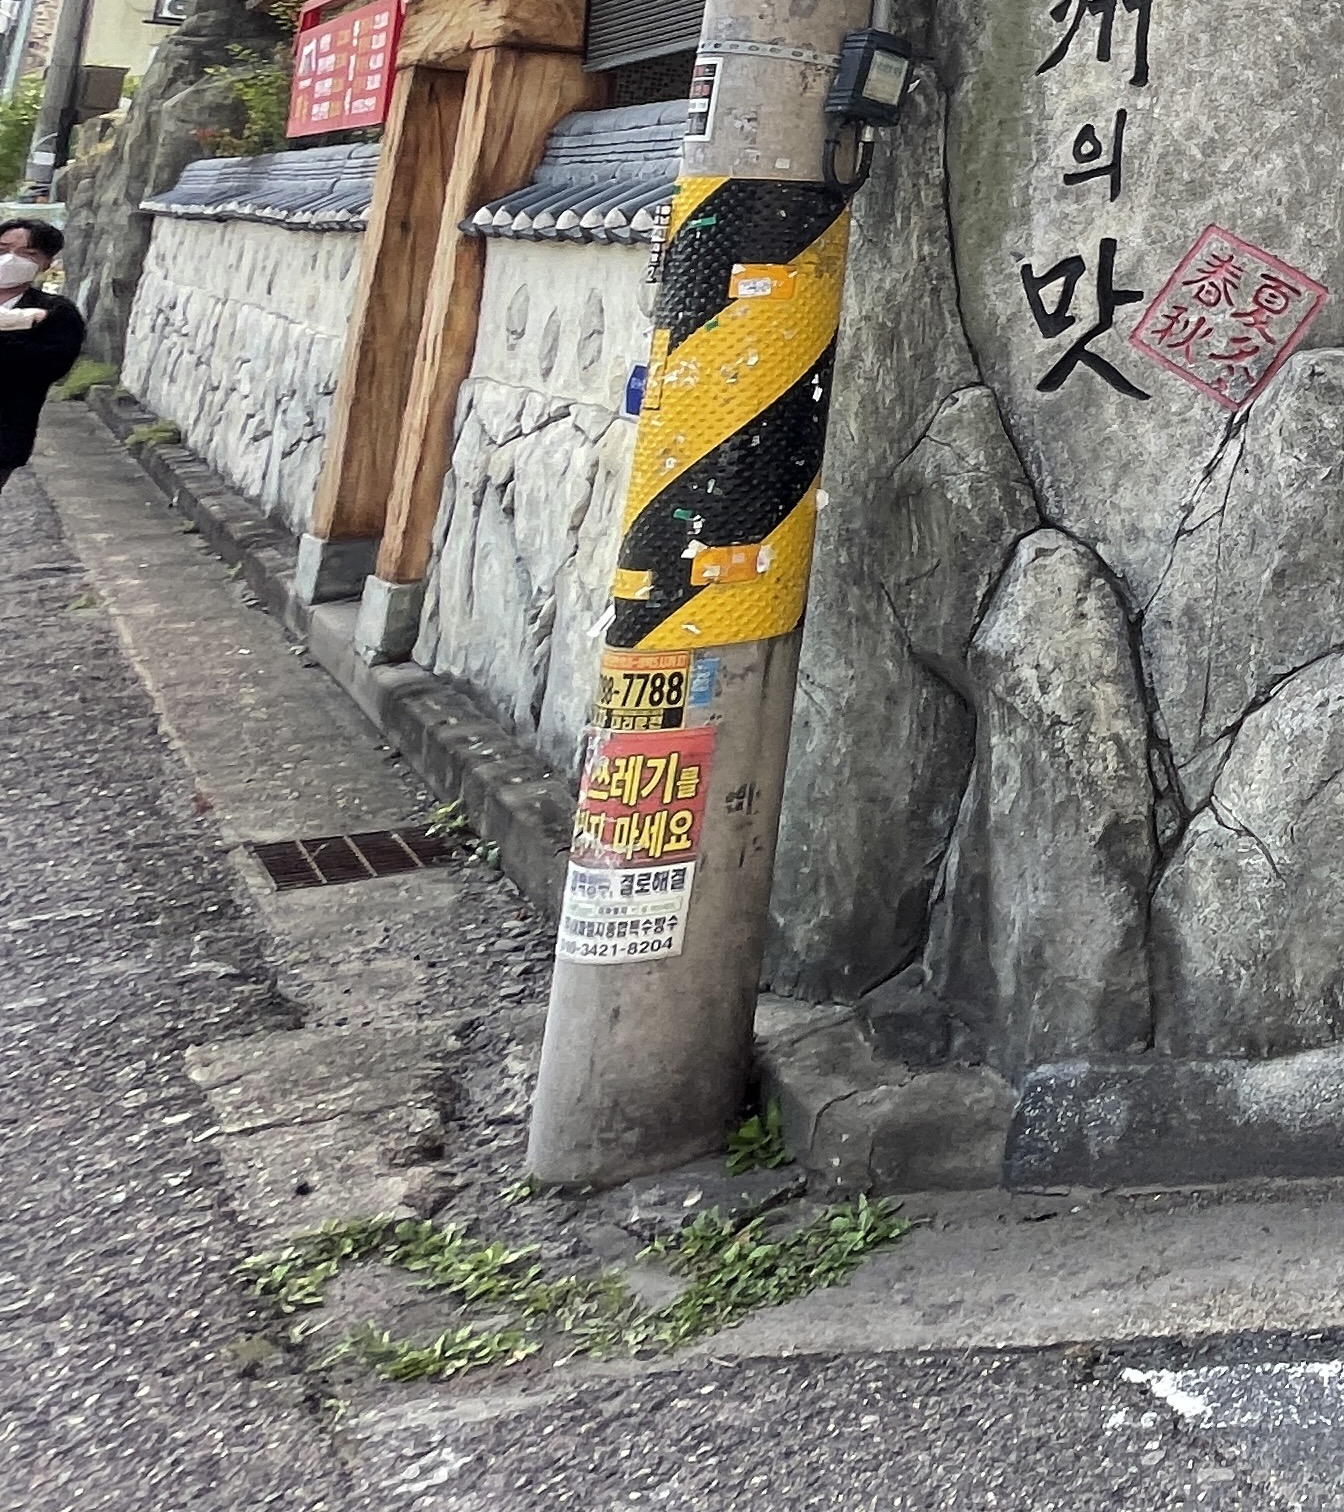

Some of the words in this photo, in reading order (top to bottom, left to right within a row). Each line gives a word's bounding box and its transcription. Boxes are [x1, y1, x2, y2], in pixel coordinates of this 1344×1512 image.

[1012, 237, 1151, 402] 맛
[587, 751, 701, 806] 쓰레기를
[612, 809, 694, 860] 마세요
[620, 867, 689, 897] 결로해결
